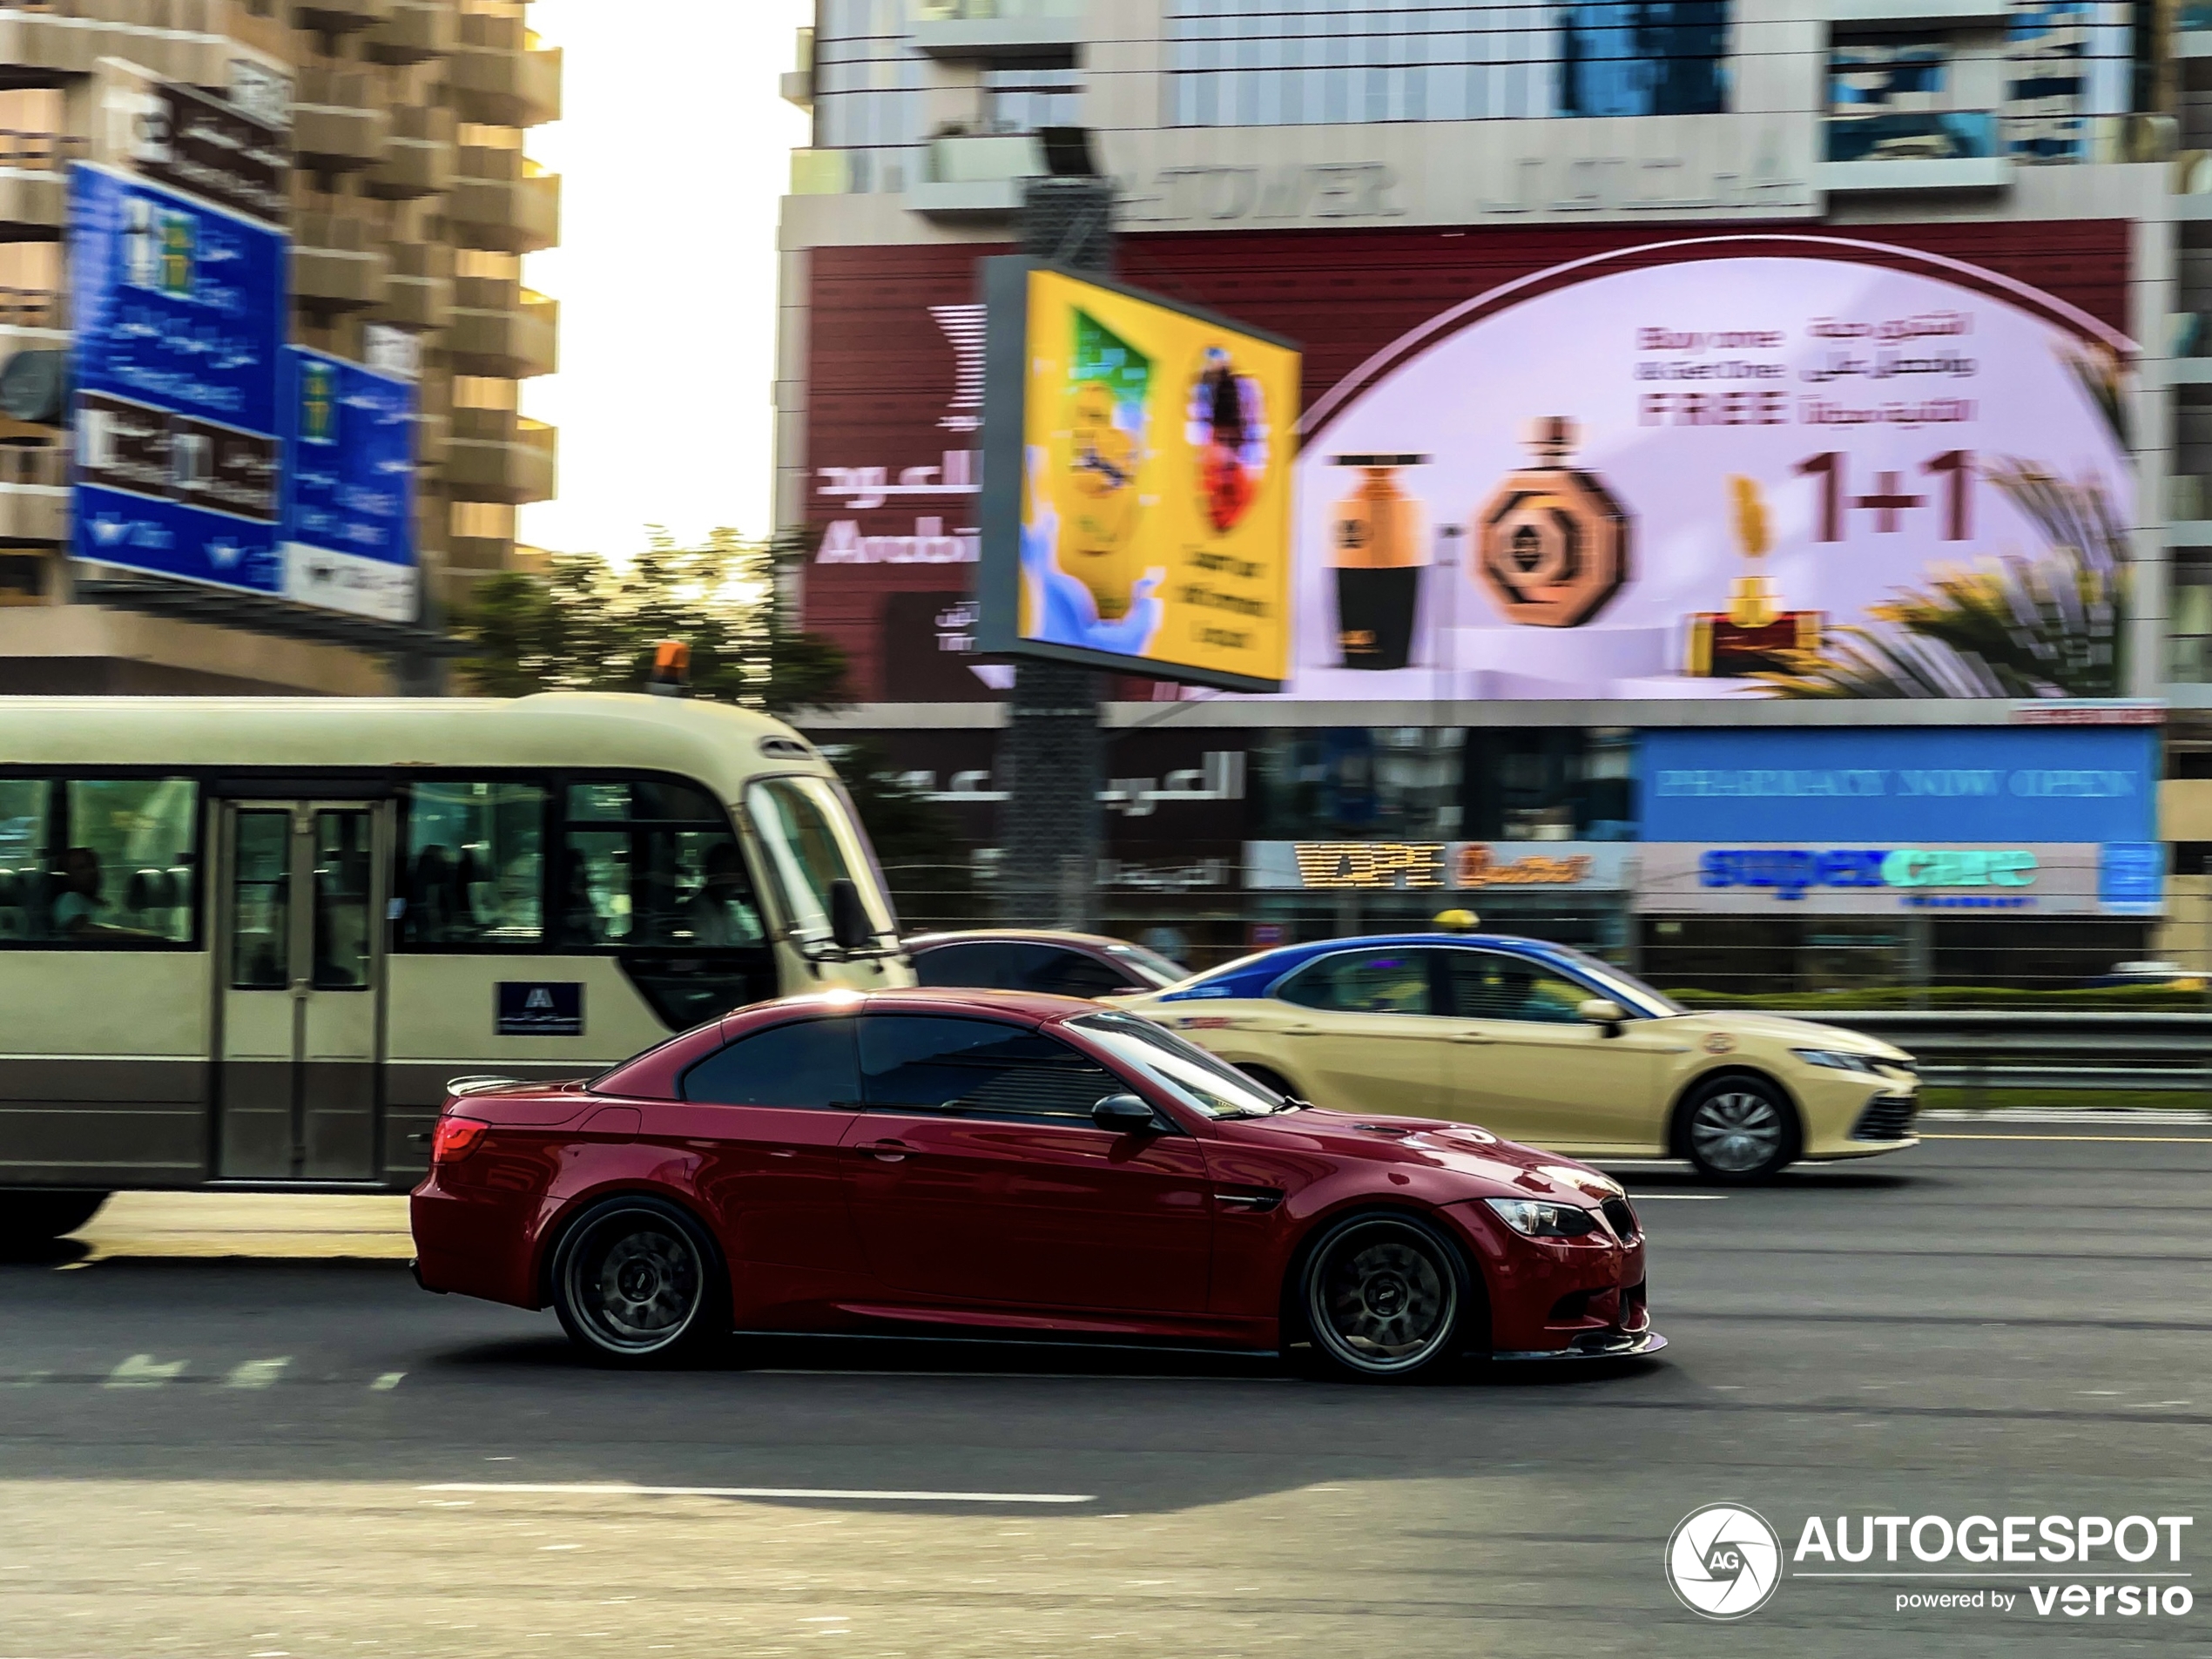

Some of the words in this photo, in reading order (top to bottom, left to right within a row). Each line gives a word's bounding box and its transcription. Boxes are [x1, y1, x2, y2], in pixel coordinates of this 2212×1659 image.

[1638, 391, 1791, 427] FREE
[1792, 450, 1977, 542] 1+1
[1656, 770, 1888, 797] PHARMACY
[1893, 770, 2006, 797] NOW
[2008, 770, 2139, 797] OPEN
